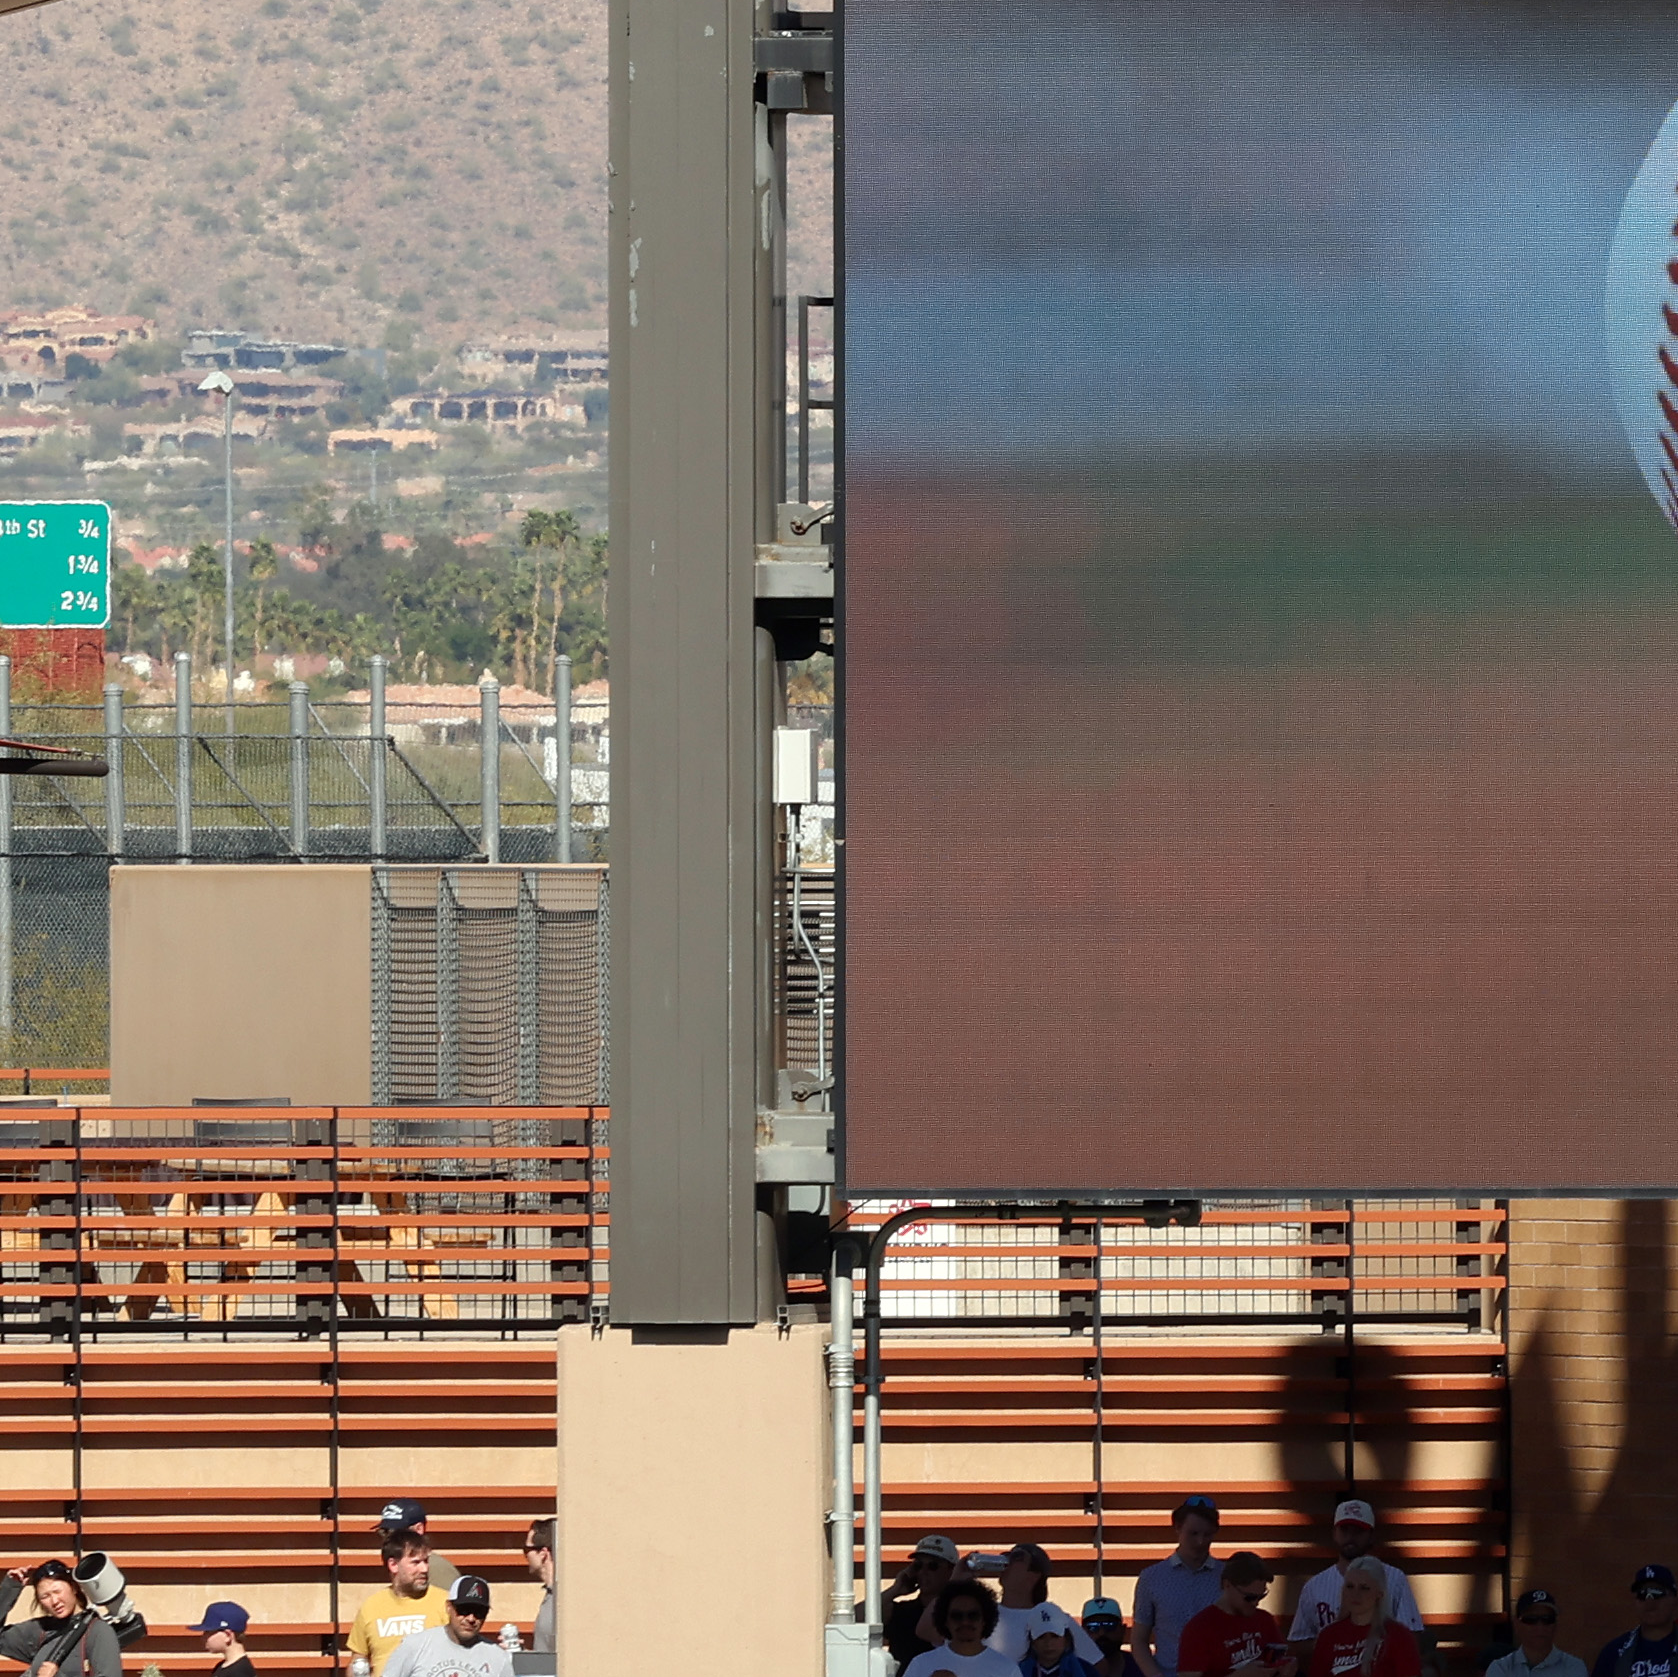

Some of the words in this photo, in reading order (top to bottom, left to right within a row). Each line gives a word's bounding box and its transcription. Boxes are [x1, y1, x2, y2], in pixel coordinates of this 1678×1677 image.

[0, 518, 21, 537] th
[27, 518, 46, 539] St
[376, 1614, 426, 1638] VANS
